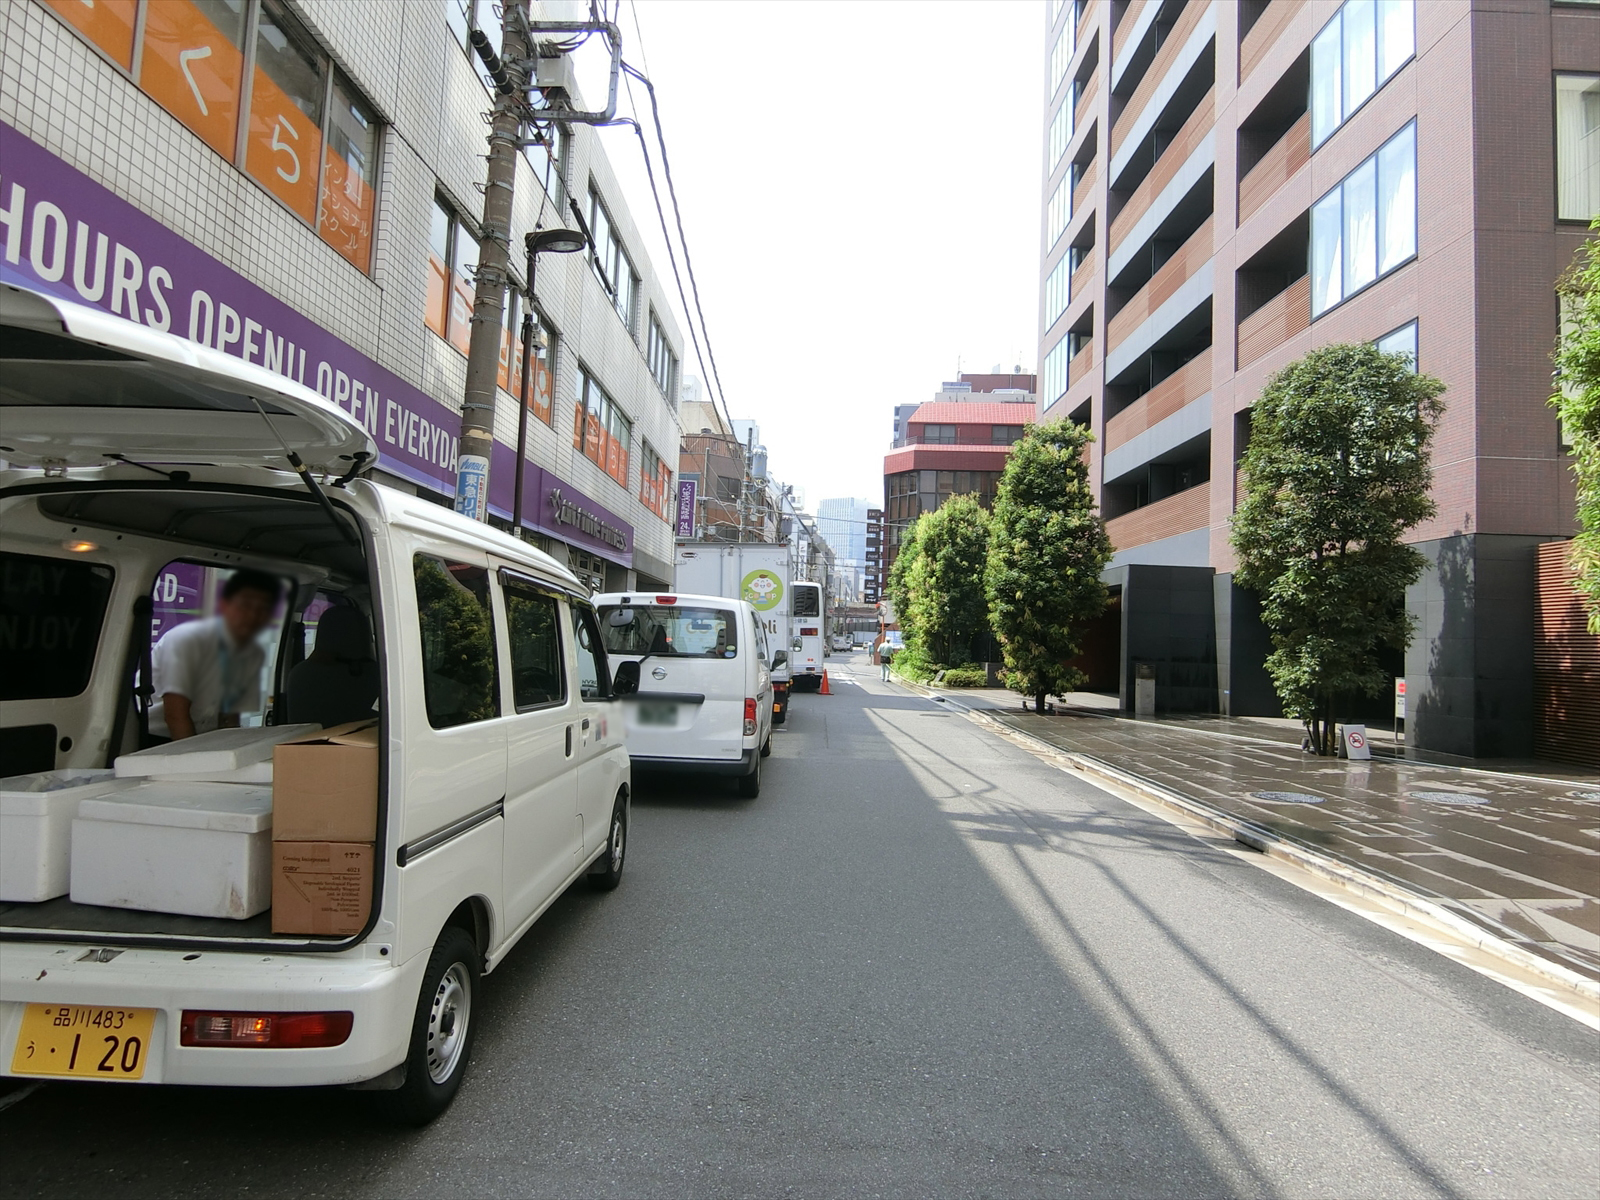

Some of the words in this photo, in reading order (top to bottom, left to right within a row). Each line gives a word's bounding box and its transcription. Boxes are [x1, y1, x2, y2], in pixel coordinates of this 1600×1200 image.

[325, 164, 361, 202] インター
[321, 207, 358, 250] スクール
[322, 186, 368, 237] ナショナル
[316, 361, 379, 436] OPEN
[385, 399, 458, 474] EVERYDA
